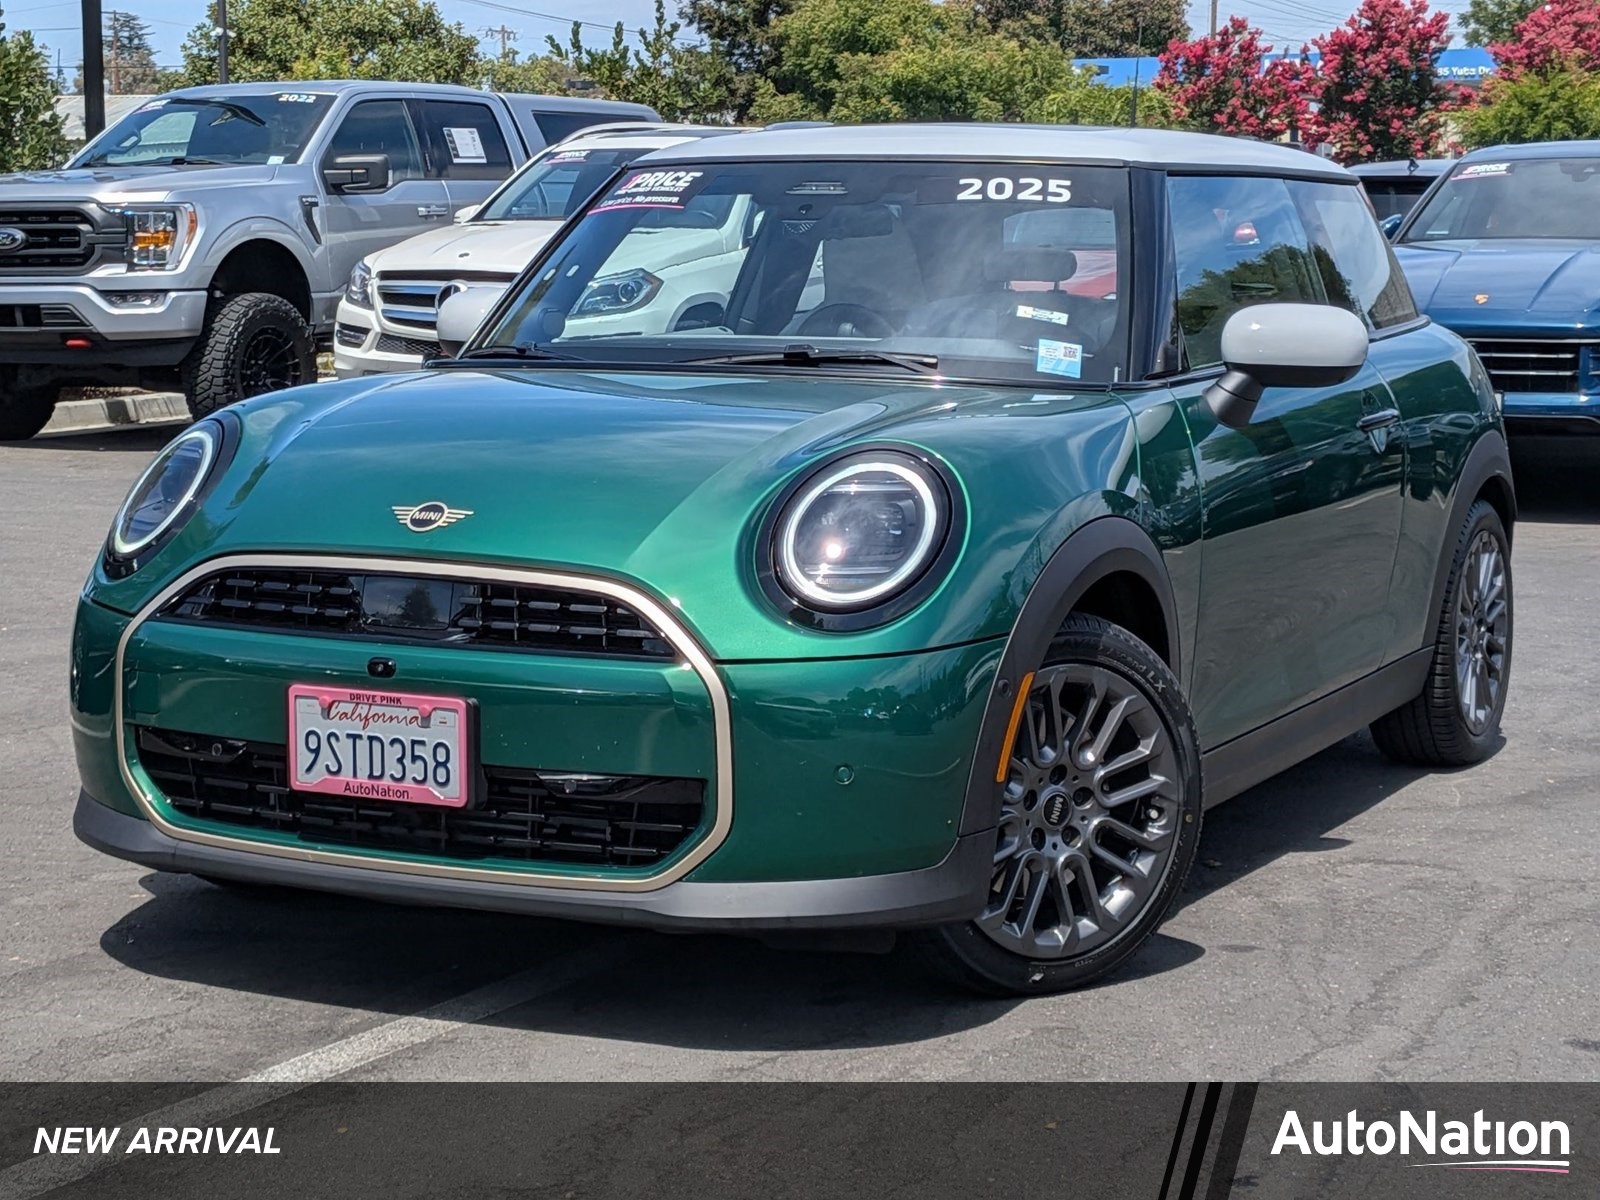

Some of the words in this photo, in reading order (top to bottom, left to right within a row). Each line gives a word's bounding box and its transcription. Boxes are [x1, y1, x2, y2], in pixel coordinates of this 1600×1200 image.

[278, 94, 316, 103] 2022
[956, 177, 1072, 203] 2025
[412, 511, 442, 521] MINI
[1146, 670, 1167, 693] LX
[349, 692, 379, 705] DRIVE
[380, 695, 402, 706] PINK
[327, 702, 421, 730] California
[304, 729, 451, 788] 9STD358
[343, 782, 410, 800] AutoNation
[1050, 796, 1063, 823] MINI
